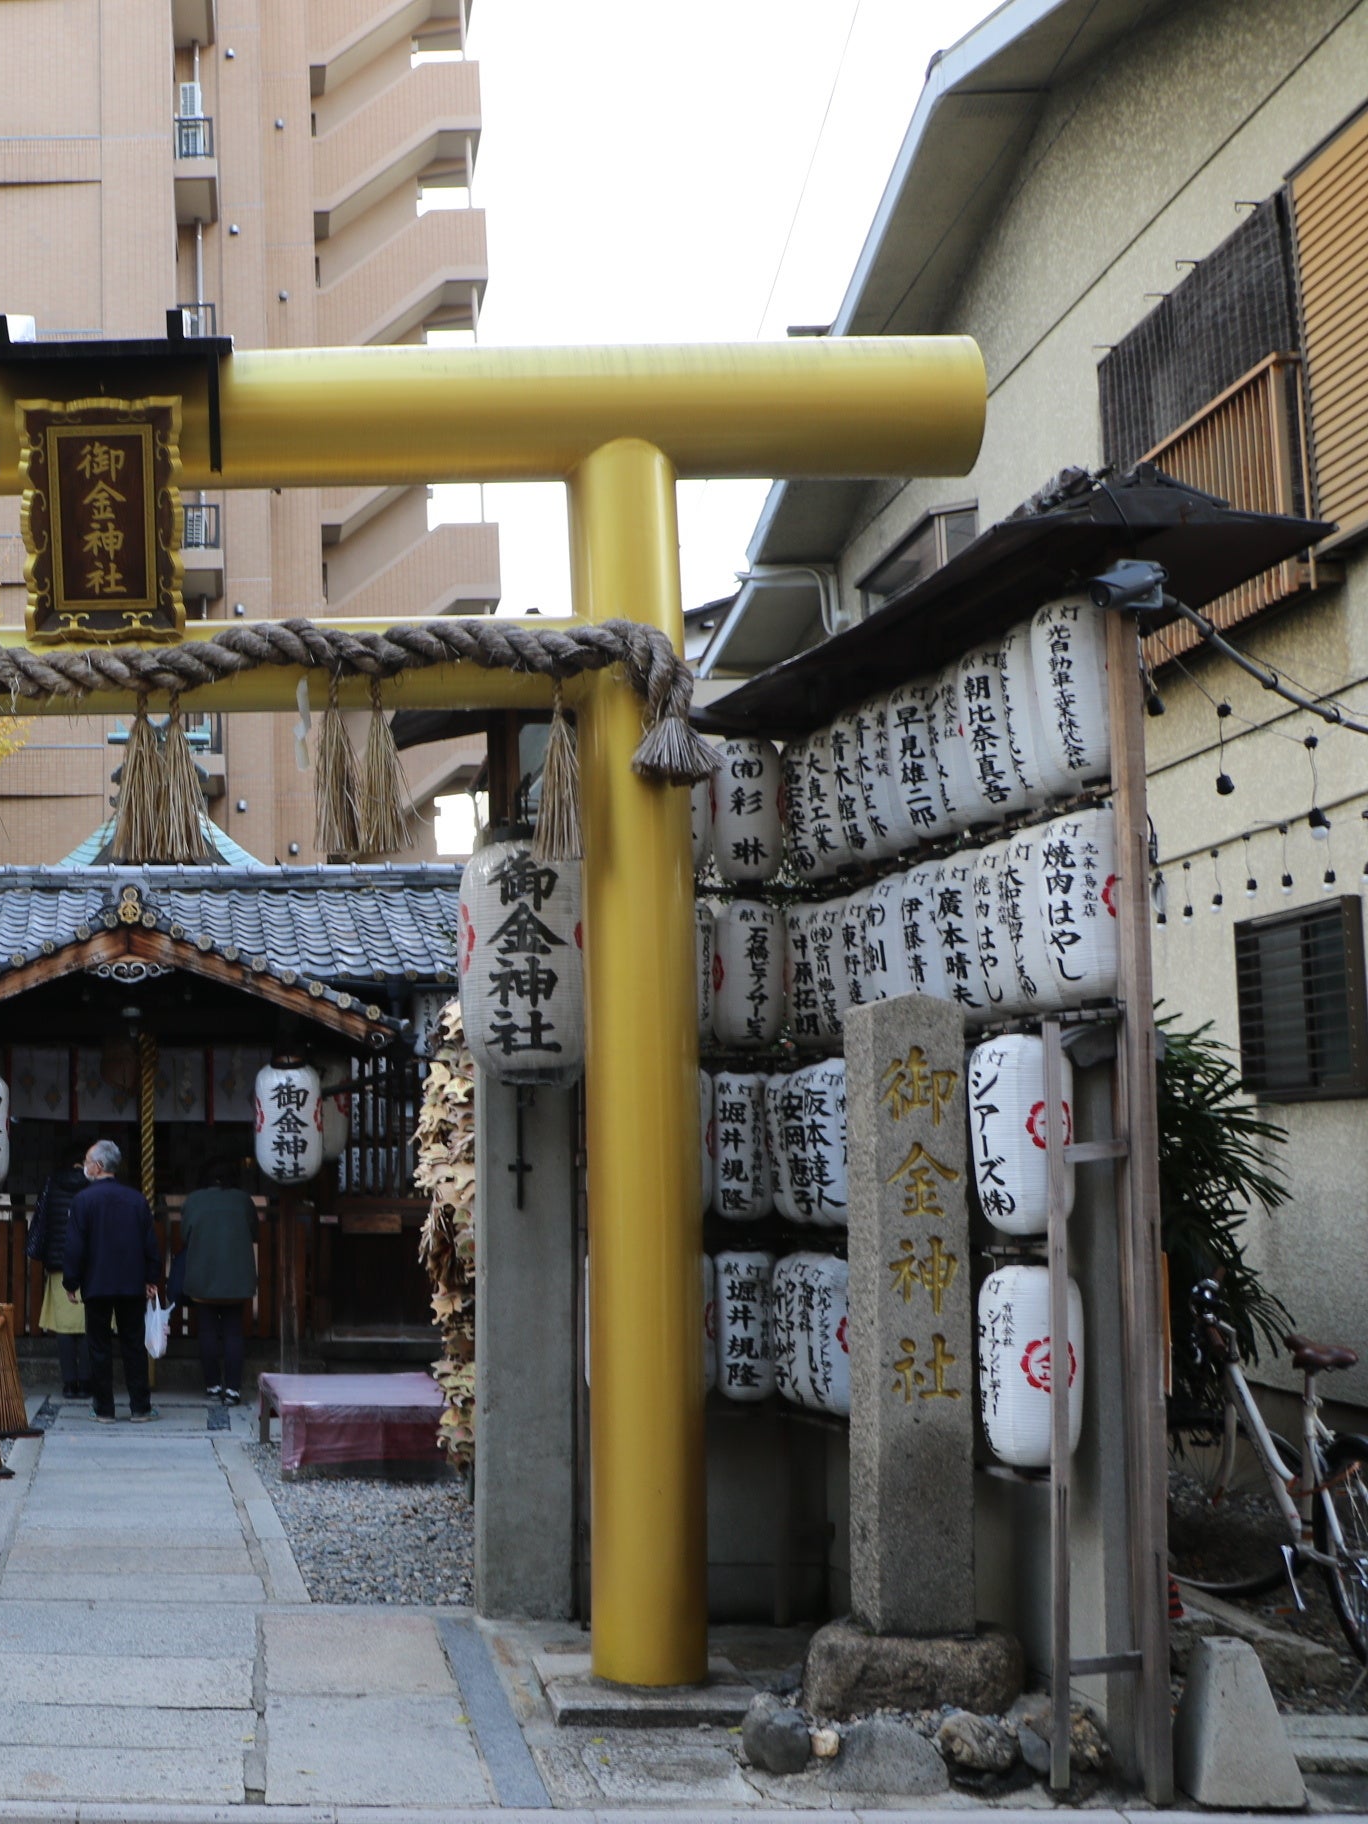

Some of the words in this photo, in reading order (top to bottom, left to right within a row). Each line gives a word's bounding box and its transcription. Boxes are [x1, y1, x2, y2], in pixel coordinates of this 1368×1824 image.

[77, 441, 127, 595] 御金神社
[964, 675, 1012, 805] 朝比奈真吾
[1048, 624, 1091, 770] 光自動車工業株式会社
[807, 753, 840, 854] 大真工業
[893, 706, 937, 829] 早見雄二郎
[486, 850, 568, 1055] 御金神社
[902, 898, 928, 991] 伊藤清
[1041, 840, 1088, 982] 焼肉はやし
[270, 1077, 310, 1181] 御金神社
[719, 1100, 753, 1210] 堀井規隆
[883, 1045, 962, 1403] 御金神社
[726, 1280, 763, 1387] 堀井規隆
